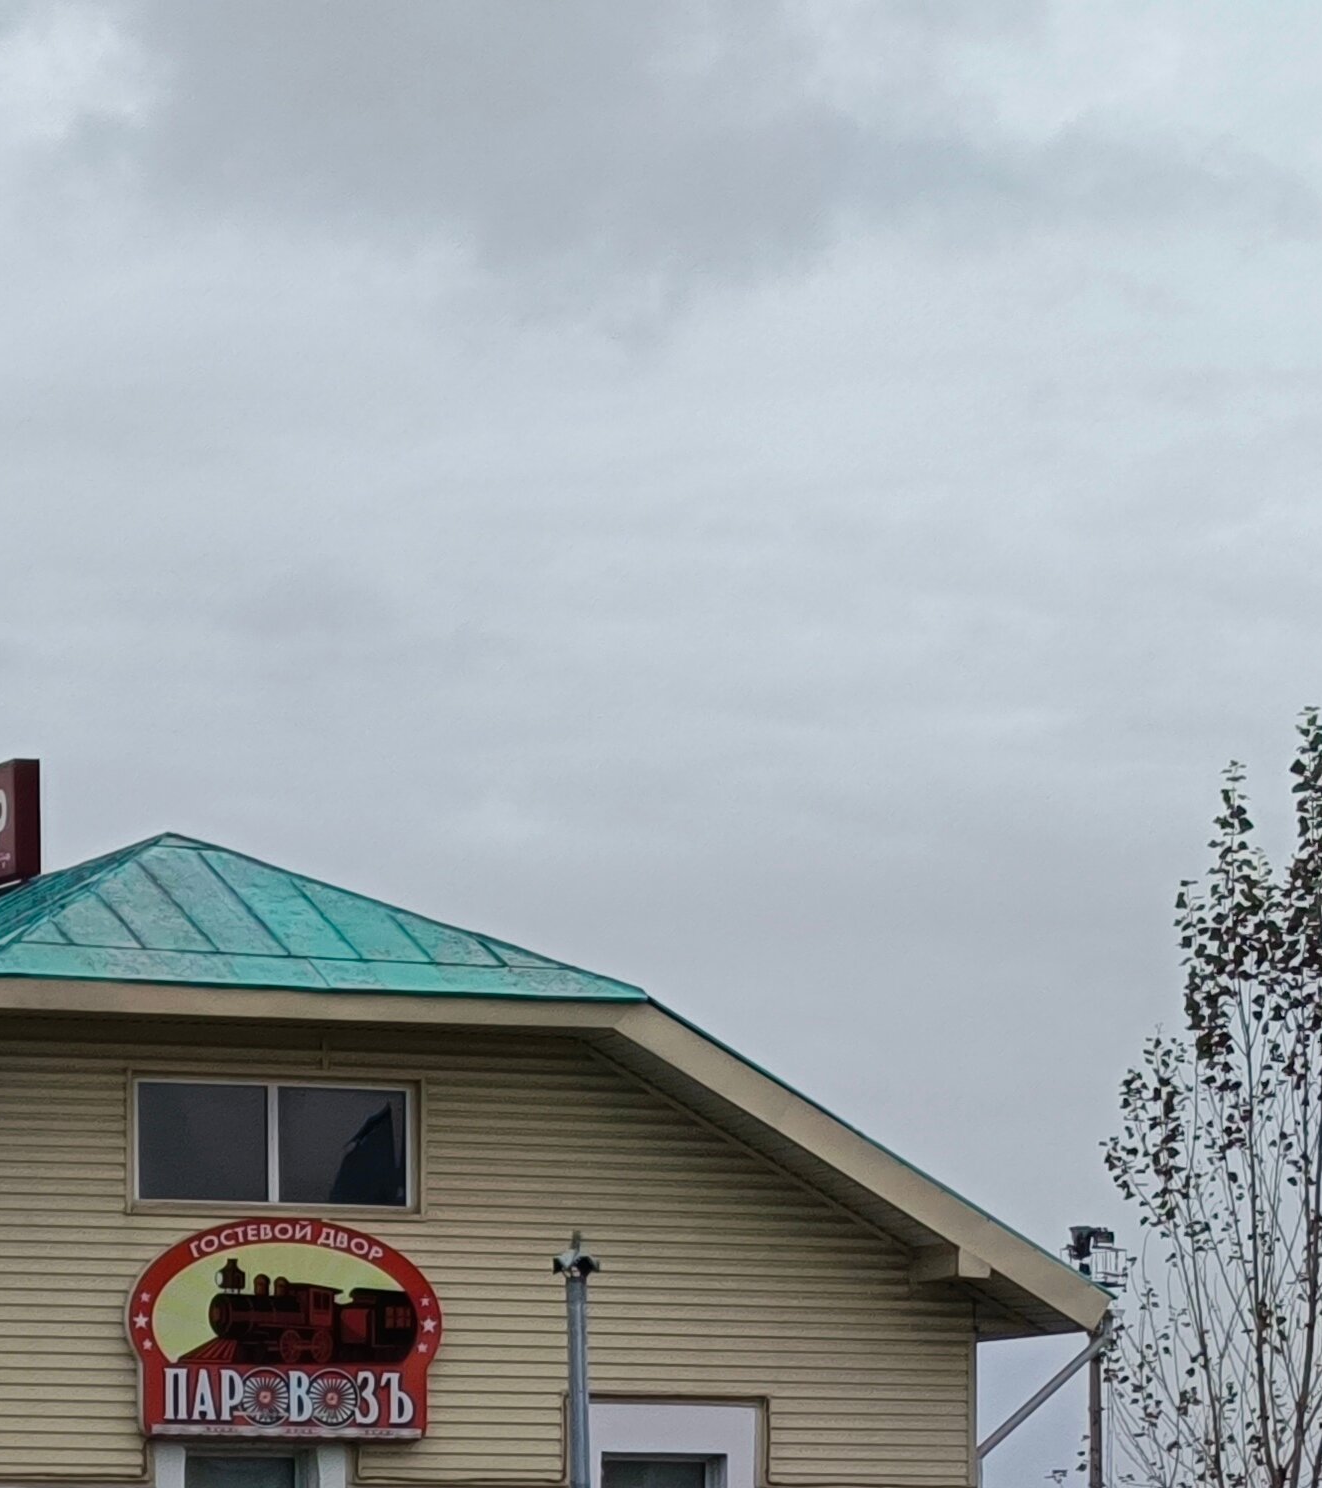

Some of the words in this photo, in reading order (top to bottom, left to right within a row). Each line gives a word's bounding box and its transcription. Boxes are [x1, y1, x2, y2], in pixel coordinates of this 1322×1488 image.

[189, 1221, 312, 1258] ГОСТЕВОЙ
[317, 1222, 384, 1261] ДВОР
[164, 1367, 413, 1427] ПАРОВОЗЪ
